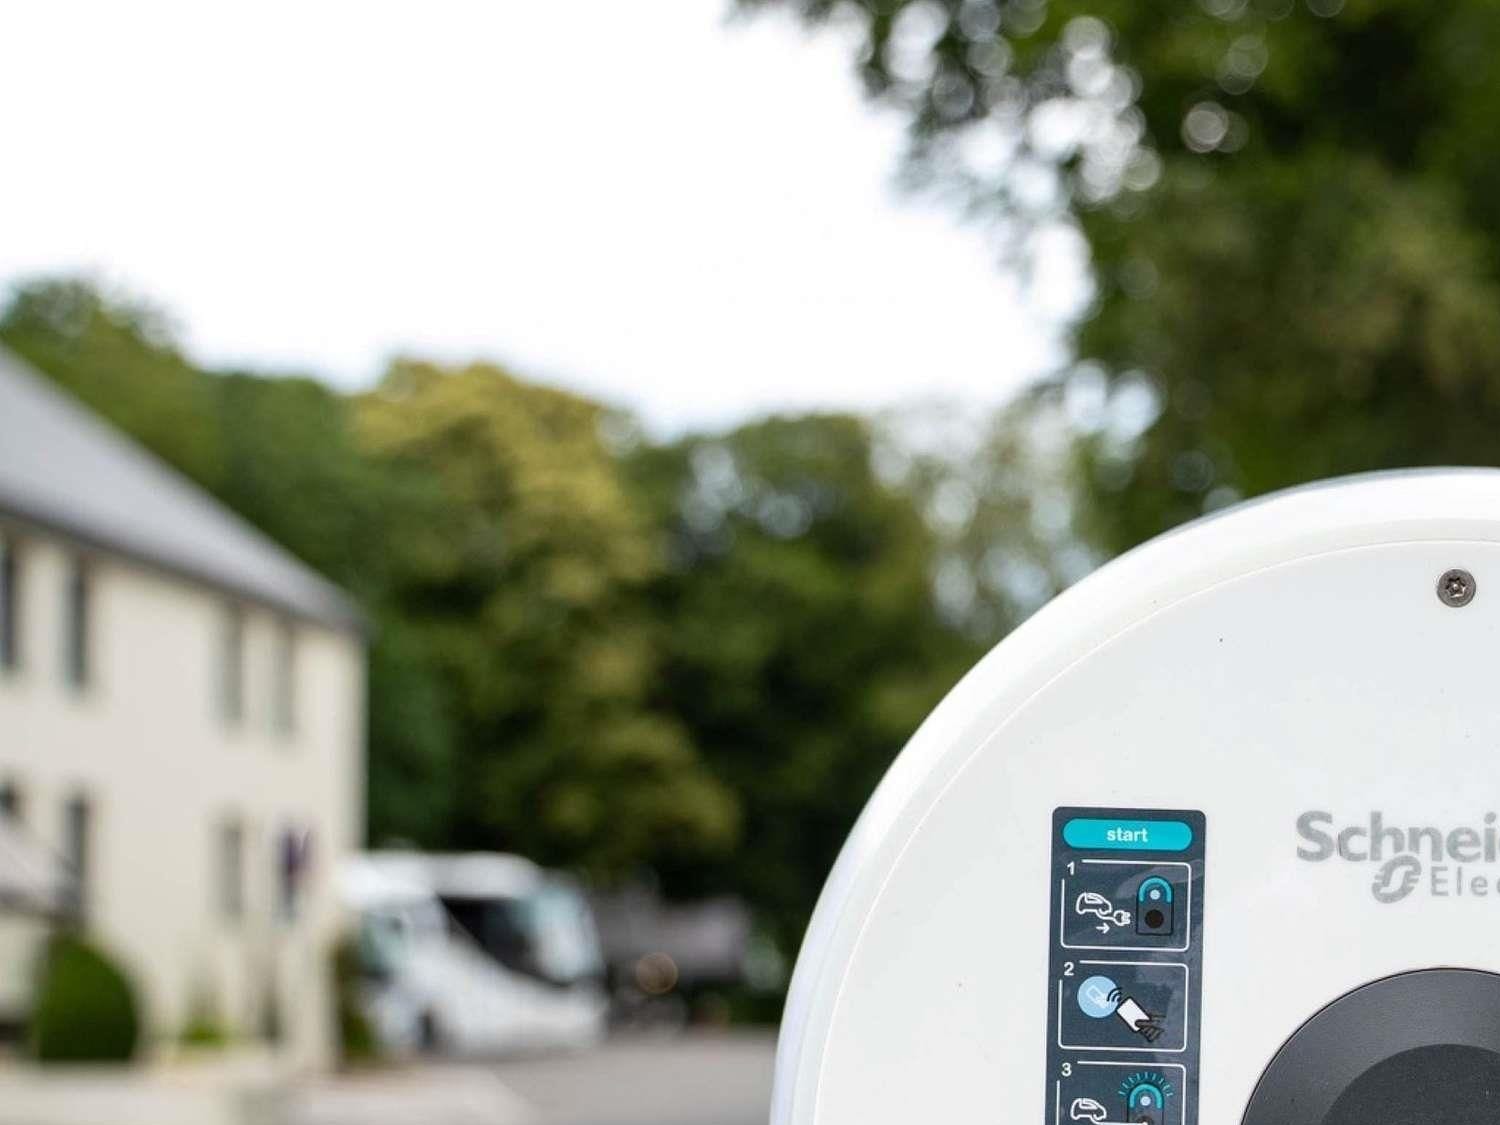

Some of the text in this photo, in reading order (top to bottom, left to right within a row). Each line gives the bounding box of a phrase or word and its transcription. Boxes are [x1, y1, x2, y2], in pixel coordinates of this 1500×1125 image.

[1107, 828, 1148, 842] start
[1067, 862, 1074, 875] 1
[1064, 962, 1074, 976] 2
[1062, 1063, 1071, 1076] 3
